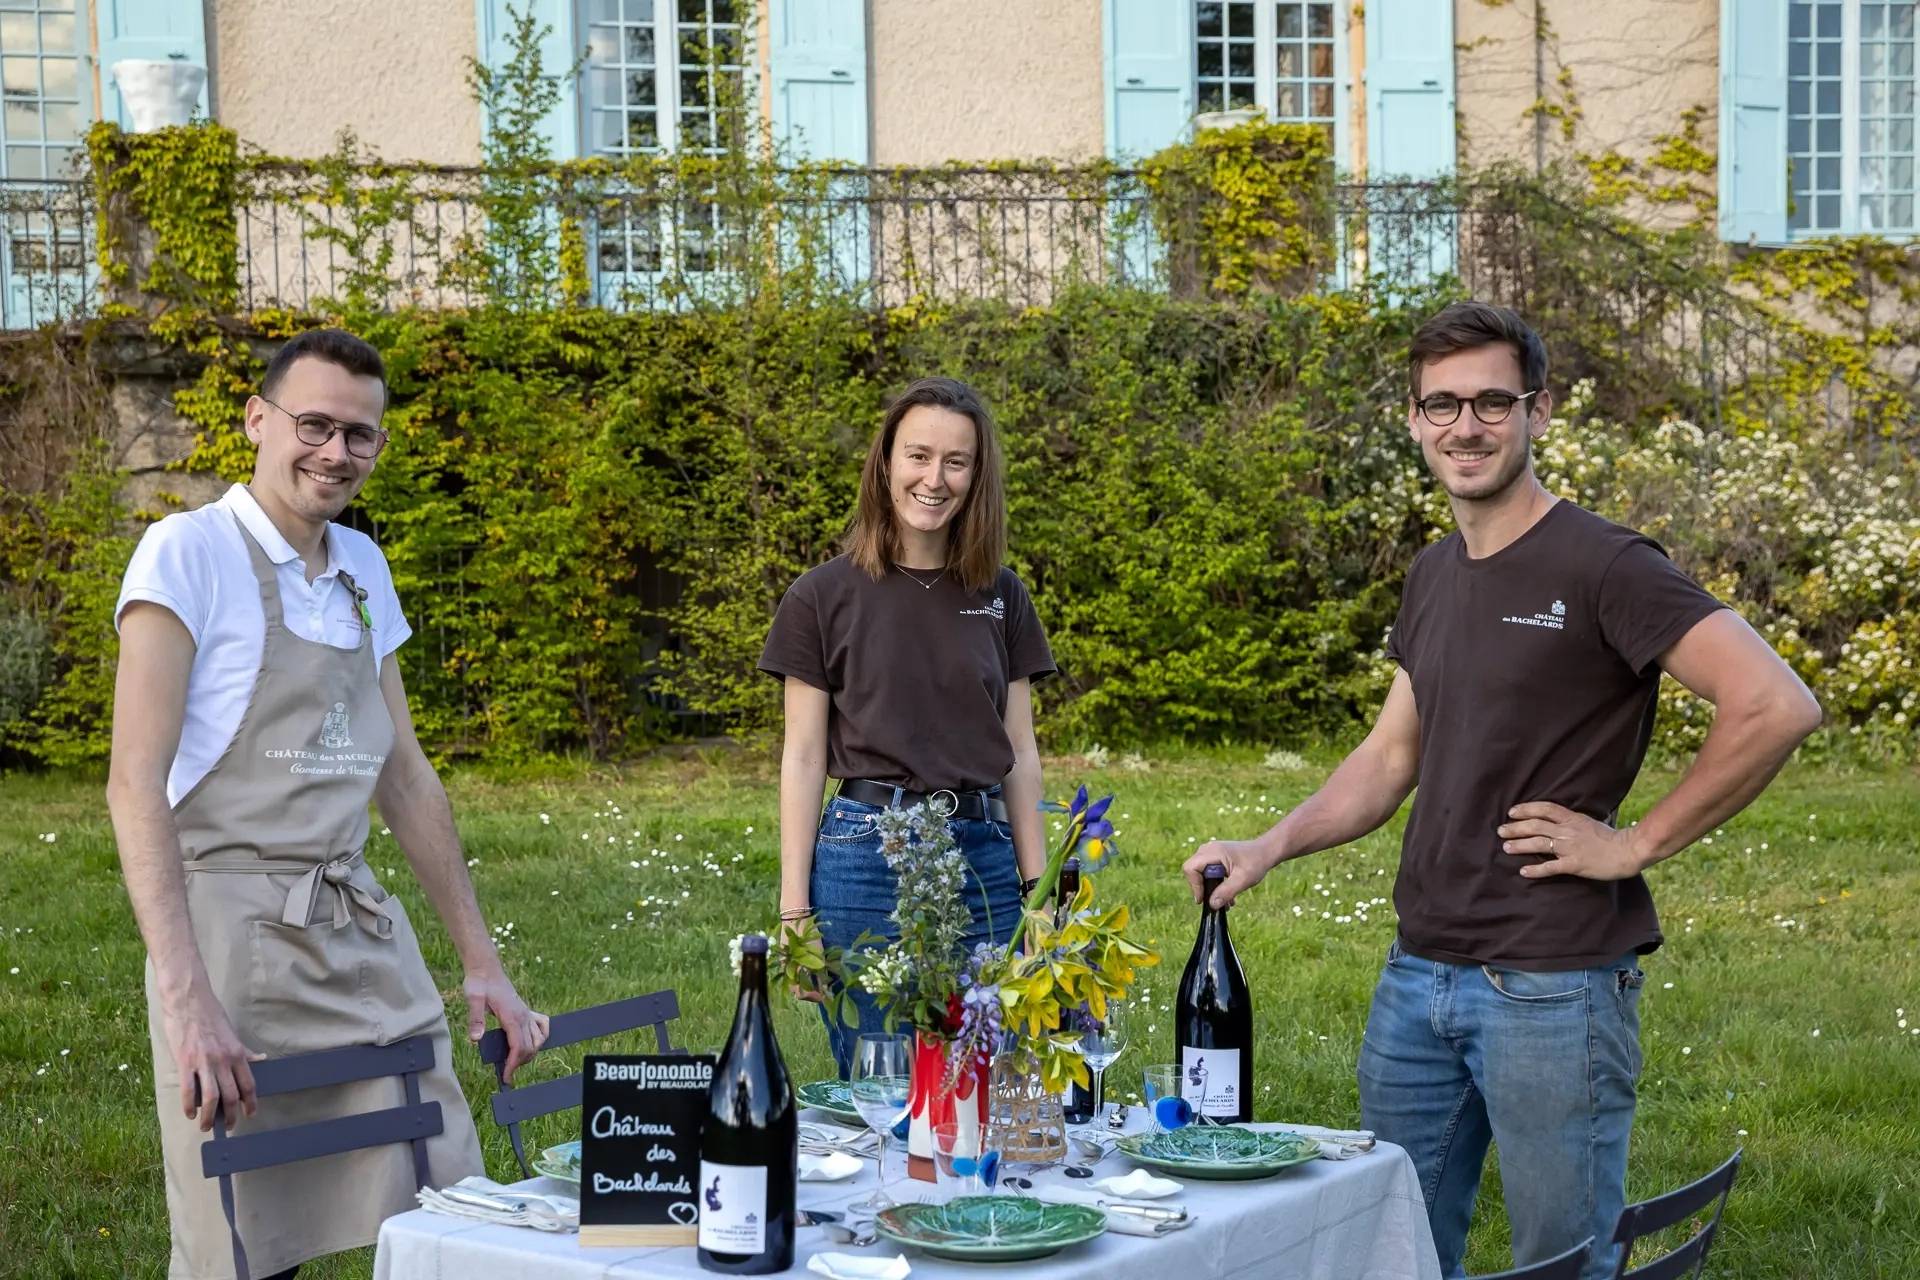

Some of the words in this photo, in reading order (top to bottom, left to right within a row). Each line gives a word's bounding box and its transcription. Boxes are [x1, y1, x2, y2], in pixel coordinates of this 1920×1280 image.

[1511, 617, 1564, 629] BACHELARDS
[265, 749, 317, 760] CHÂTEAU
[594, 1061, 713, 1090] Beaujonomie
[646, 1080, 659, 1089] BY
[591, 1105, 676, 1138] Château
[646, 1143, 676, 1162] des
[592, 1171, 692, 1194] Bachelards
